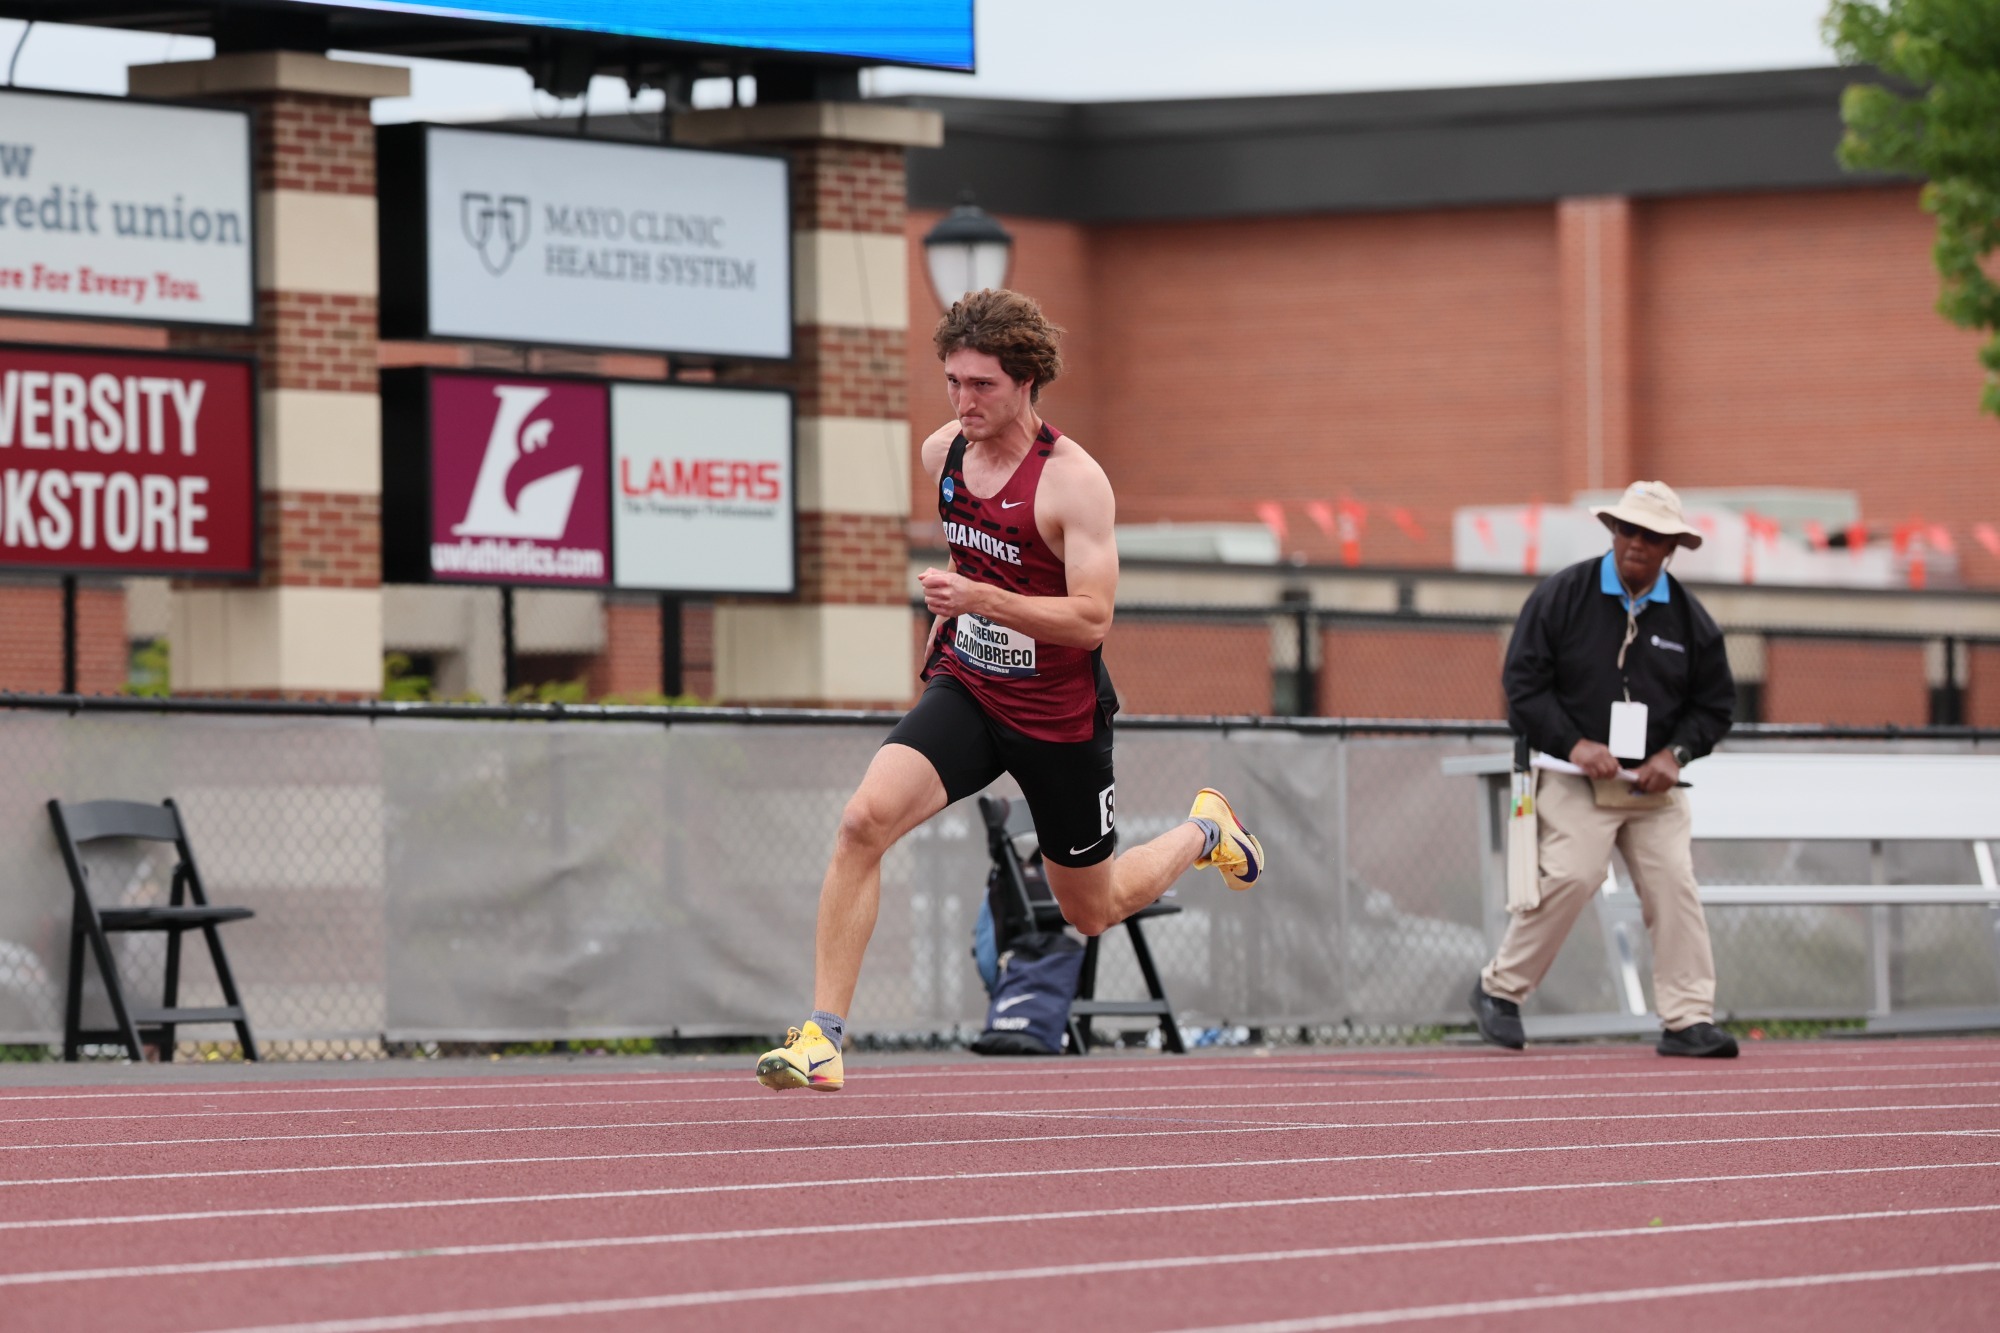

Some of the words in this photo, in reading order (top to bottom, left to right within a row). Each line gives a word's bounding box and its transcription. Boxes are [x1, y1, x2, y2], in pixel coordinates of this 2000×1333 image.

[112, 196, 243, 244] union
[545, 203, 626, 242] MAYO
[627, 208, 727, 248] CLINIC
[32, 262, 70, 293] For
[78, 266, 147, 304] Every
[544, 243, 651, 284] HEALTH
[654, 251, 757, 292] SYSTEM
[621, 457, 780, 503] LAMERS
[0, 468, 210, 553] KSTORE
[942, 521, 1022, 566] ROANOKE
[956, 630, 1033, 667] CAMOBRECO
[969, 620, 1009, 646] LORENZO
[1105, 789, 1115, 829] 8
